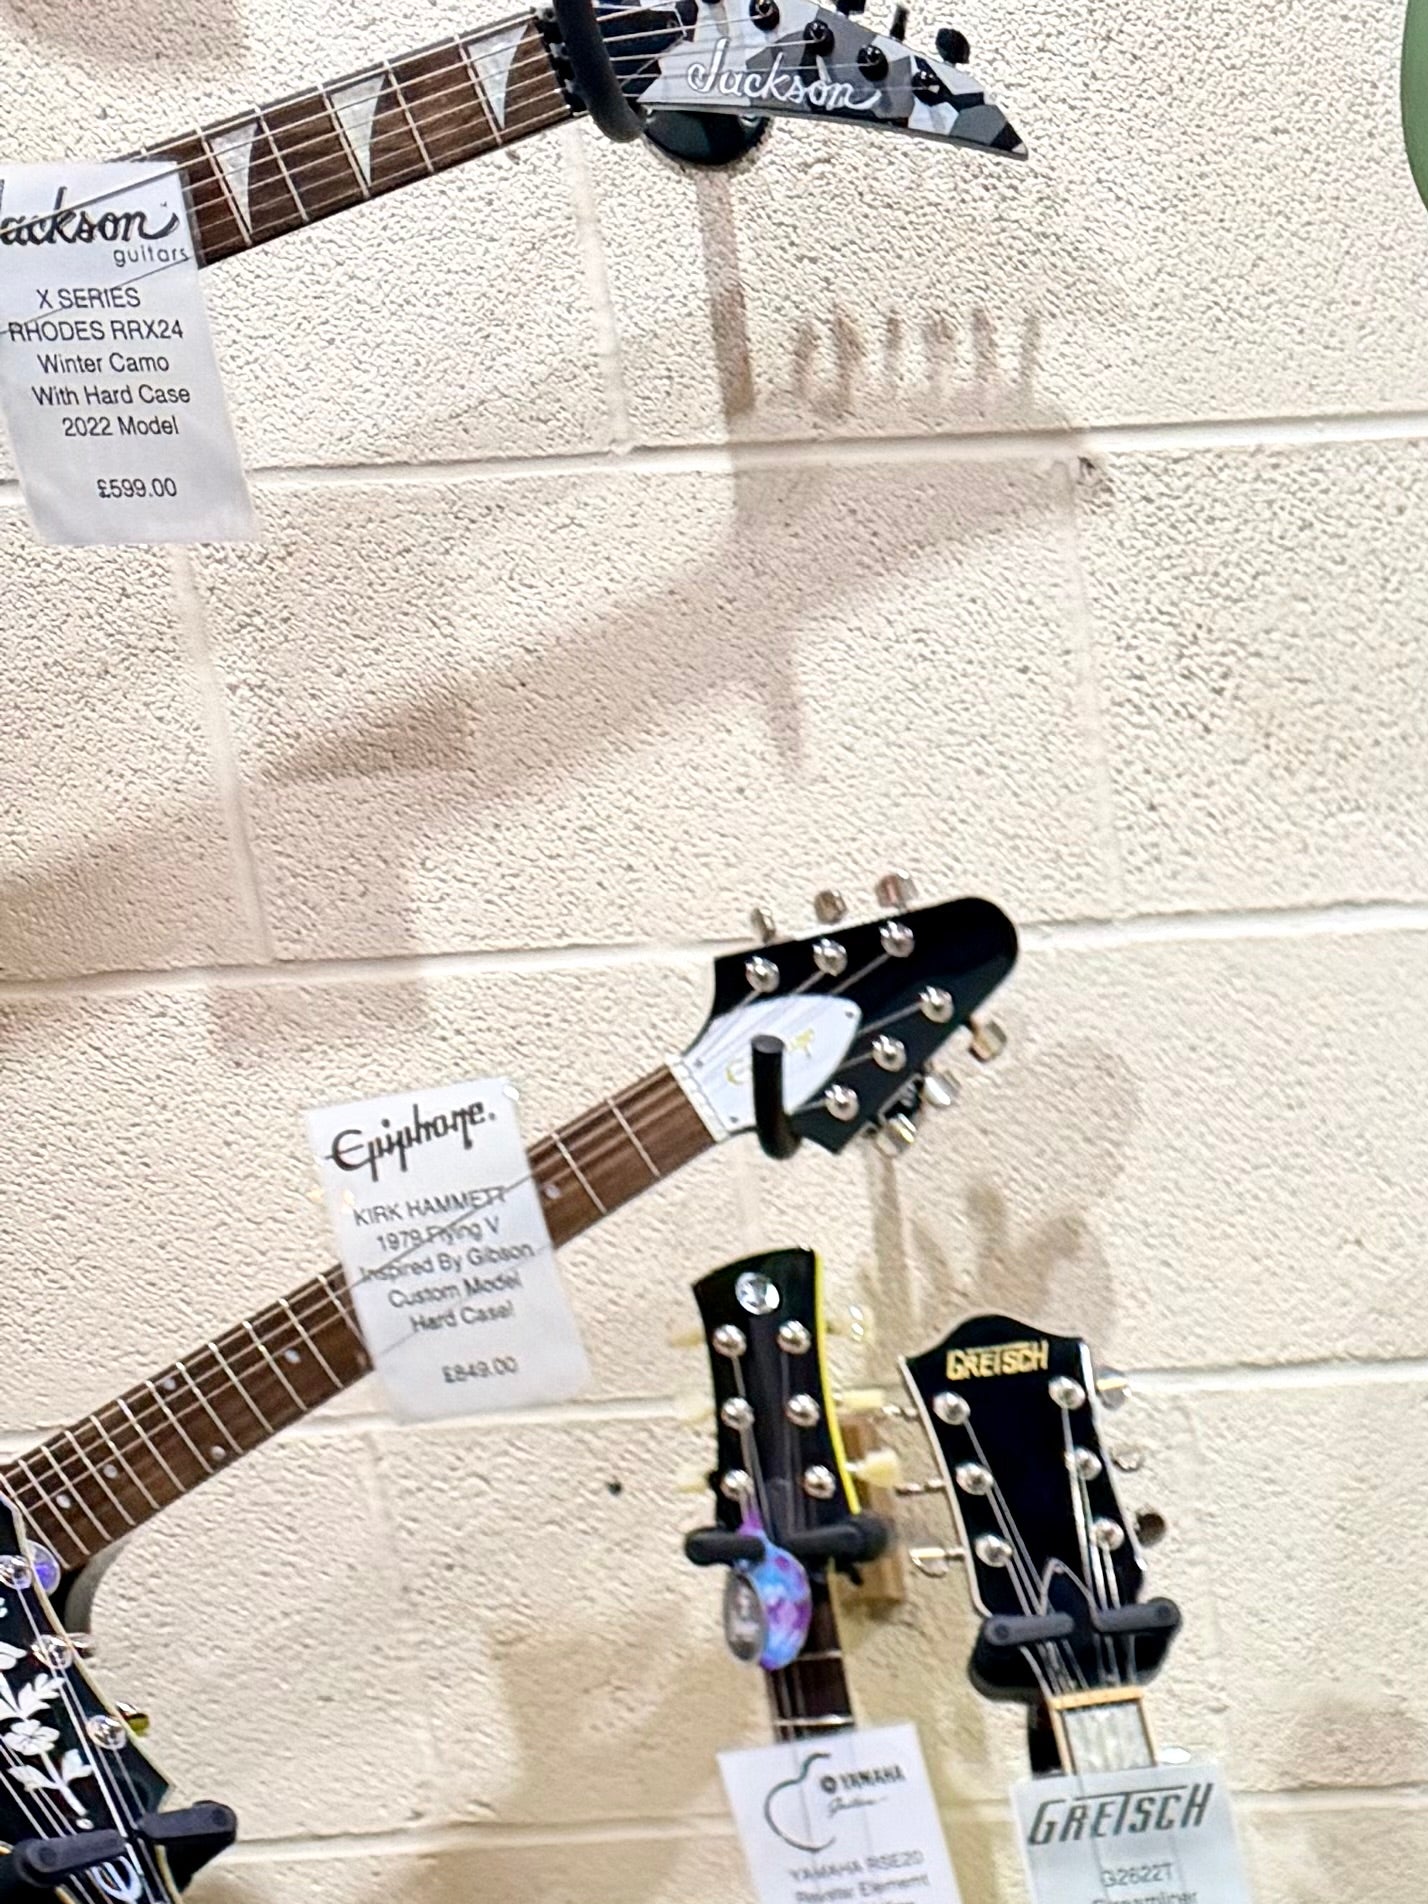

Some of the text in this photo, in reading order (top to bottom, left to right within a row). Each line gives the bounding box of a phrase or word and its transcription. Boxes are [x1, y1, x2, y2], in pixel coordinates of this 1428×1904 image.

[687, 37, 882, 111] Jackson
[0, 180, 181, 246] ackson
[113, 245, 191, 268] guitars
[36, 287, 141, 309] X SERIES
[8, 319, 184, 343] RHODES RRX24
[37, 353, 171, 375] Winter Camo
[31, 384, 191, 406] With Hard Case
[62, 416, 180, 437] 2022 Model
[97, 478, 178, 499] £599.00
[352, 1203, 400, 1228] KIRK
[486, 1216, 501, 1235] V
[438, 1250, 462, 1275] By
[466, 1242, 537, 1269] Gibson
[388, 1268, 523, 1309] Custom Model
[409, 1307, 457, 1334] Hard
[946, 1339, 1049, 1381] GRETSCH
[841, 1764, 906, 1792] YAMAHA
[1027, 1783, 1215, 1847] GRETSCH
